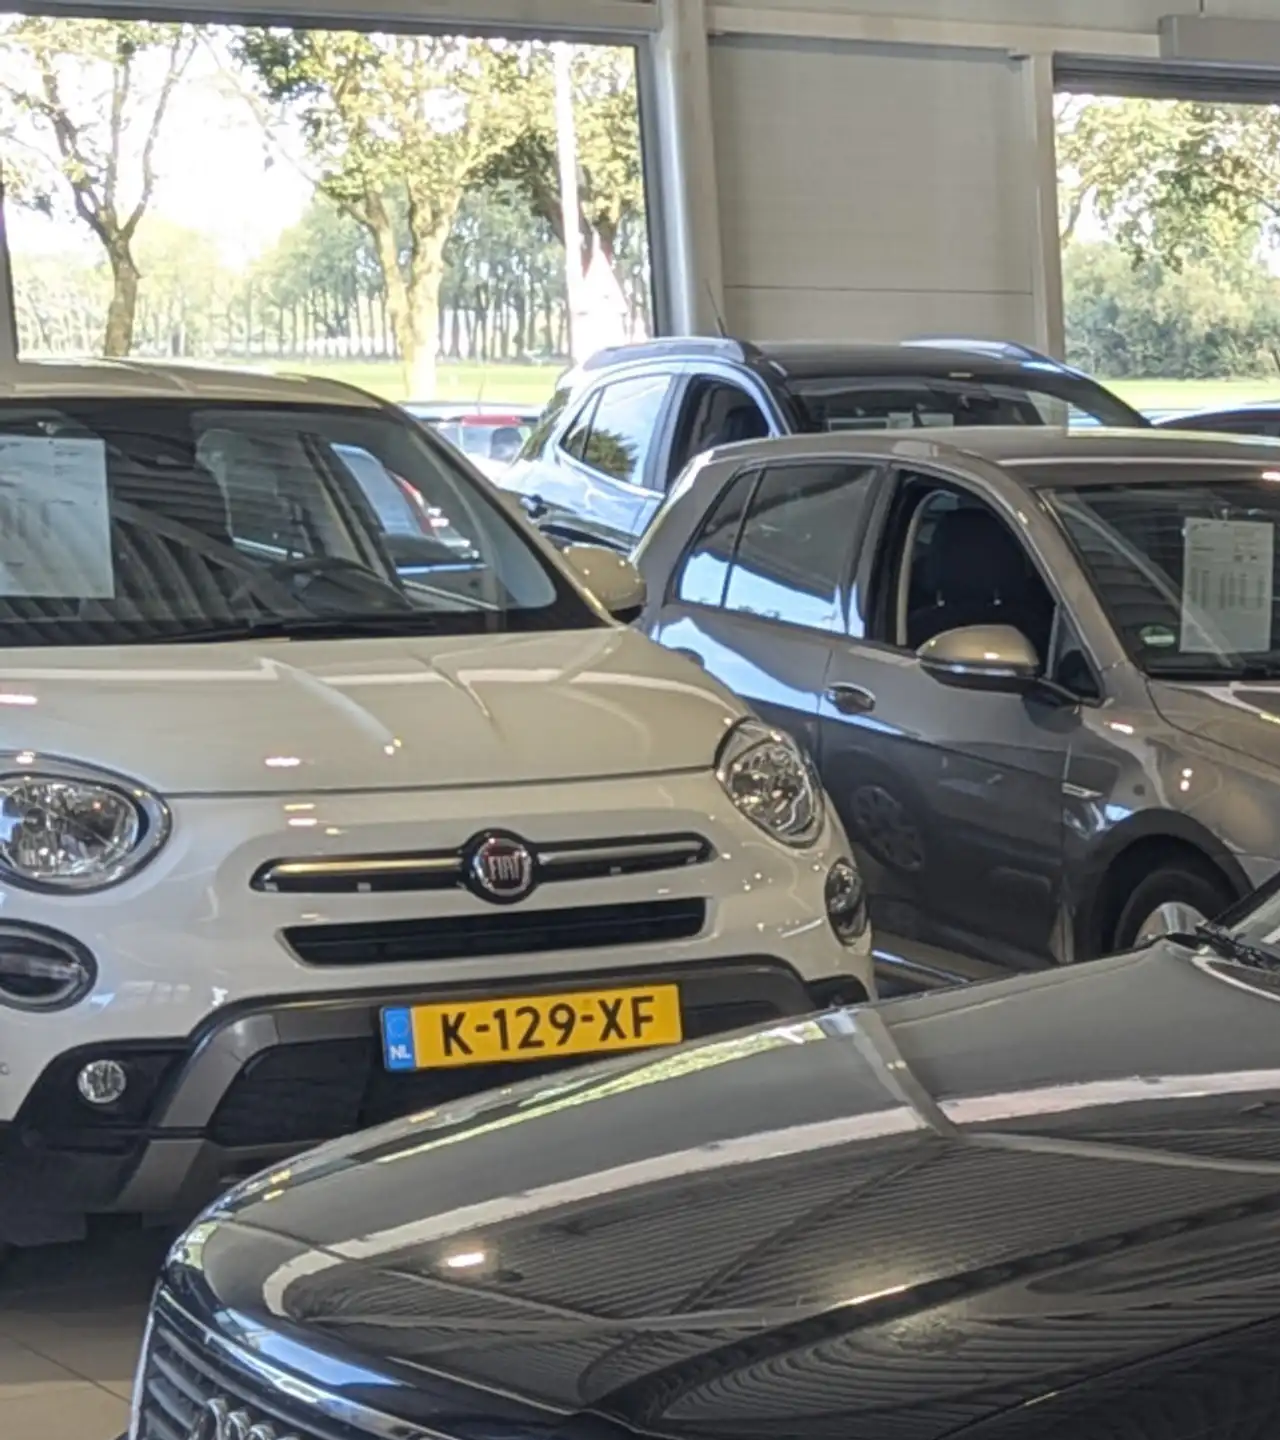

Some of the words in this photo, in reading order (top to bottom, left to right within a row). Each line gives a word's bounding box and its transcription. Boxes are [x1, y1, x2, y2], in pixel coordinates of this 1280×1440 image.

[487, 851, 520, 881] FIAT
[440, 995, 655, 1057] K-129-XF
[389, 1044, 412, 1061] NL
